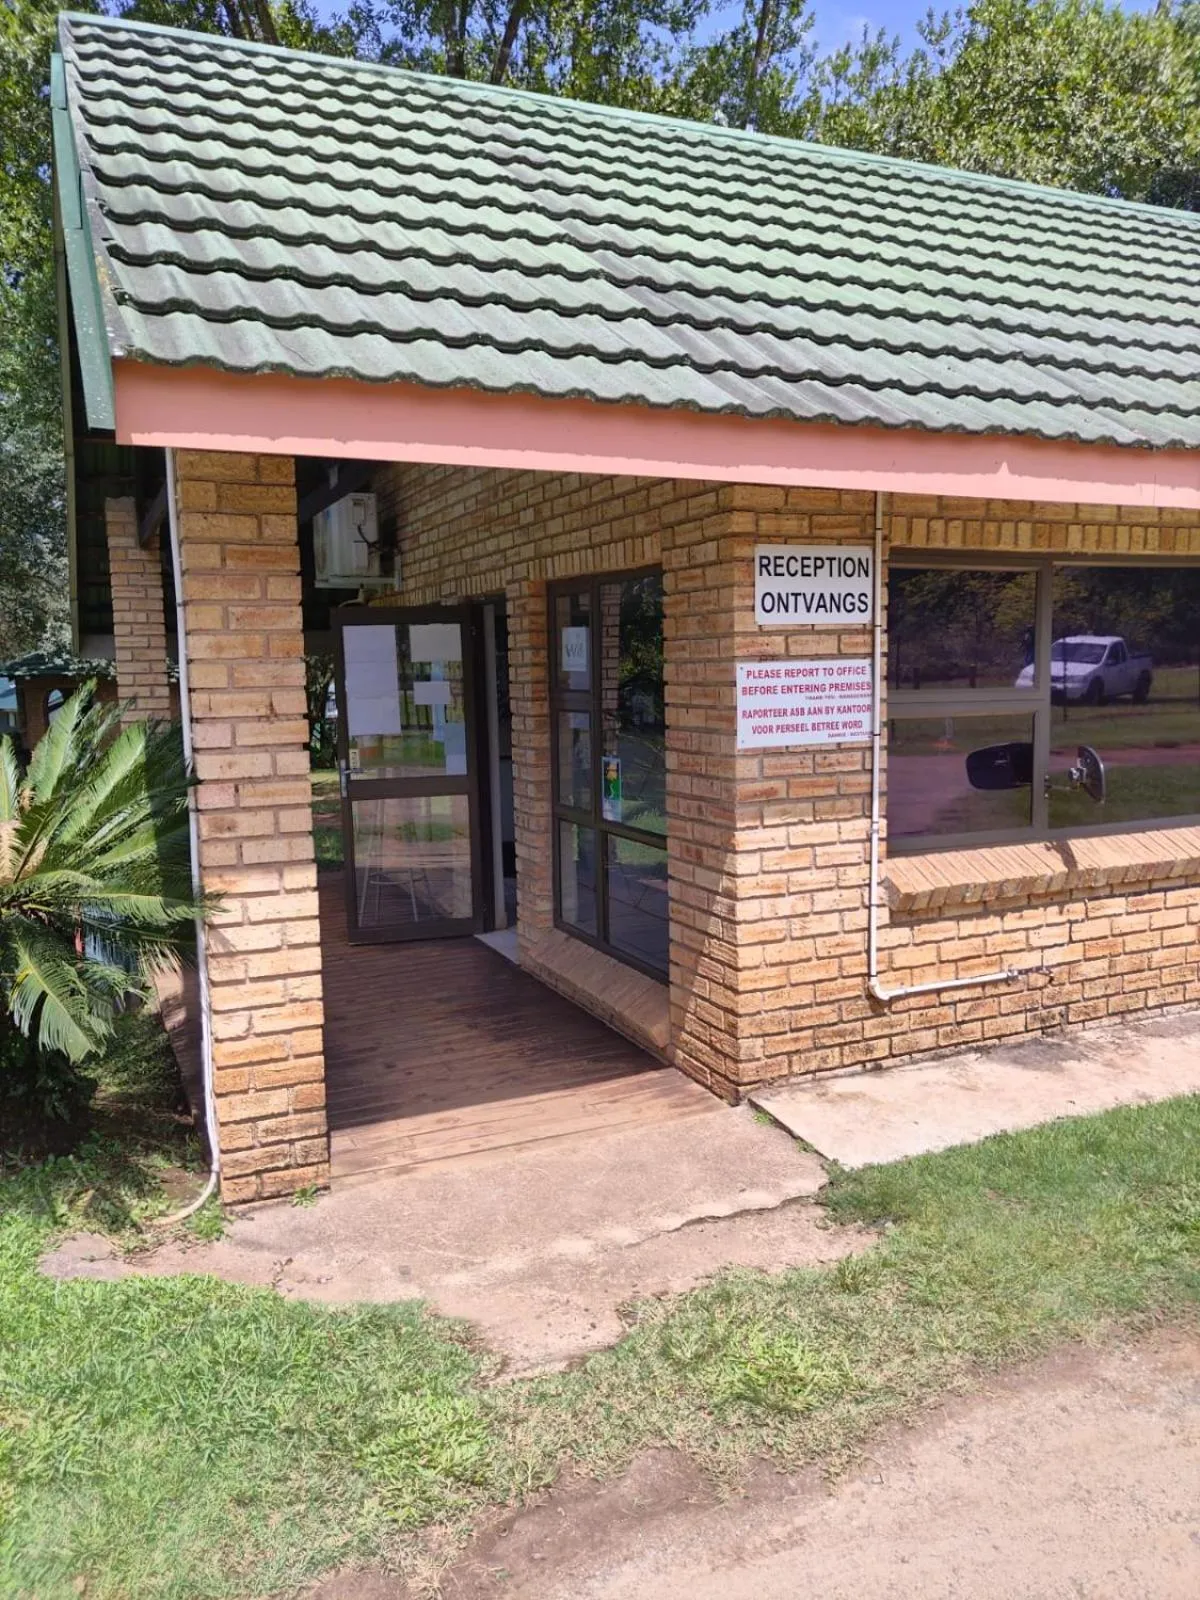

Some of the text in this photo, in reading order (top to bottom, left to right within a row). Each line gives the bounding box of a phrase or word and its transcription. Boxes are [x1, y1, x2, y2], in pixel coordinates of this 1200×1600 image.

[759, 555, 869, 578] RECEPTION
[761, 591, 869, 614] ONTVANGS
[746, 666, 867, 679] PLEASE REPORT TO OFFICE
[742, 681, 872, 696] BEFORE ENTERING PREMISES
[742, 704, 872, 719] RAPORTEER ASB AAN BY KANTOOR
[752, 720, 863, 735] VOOR PERSEEL BETREE WORD
